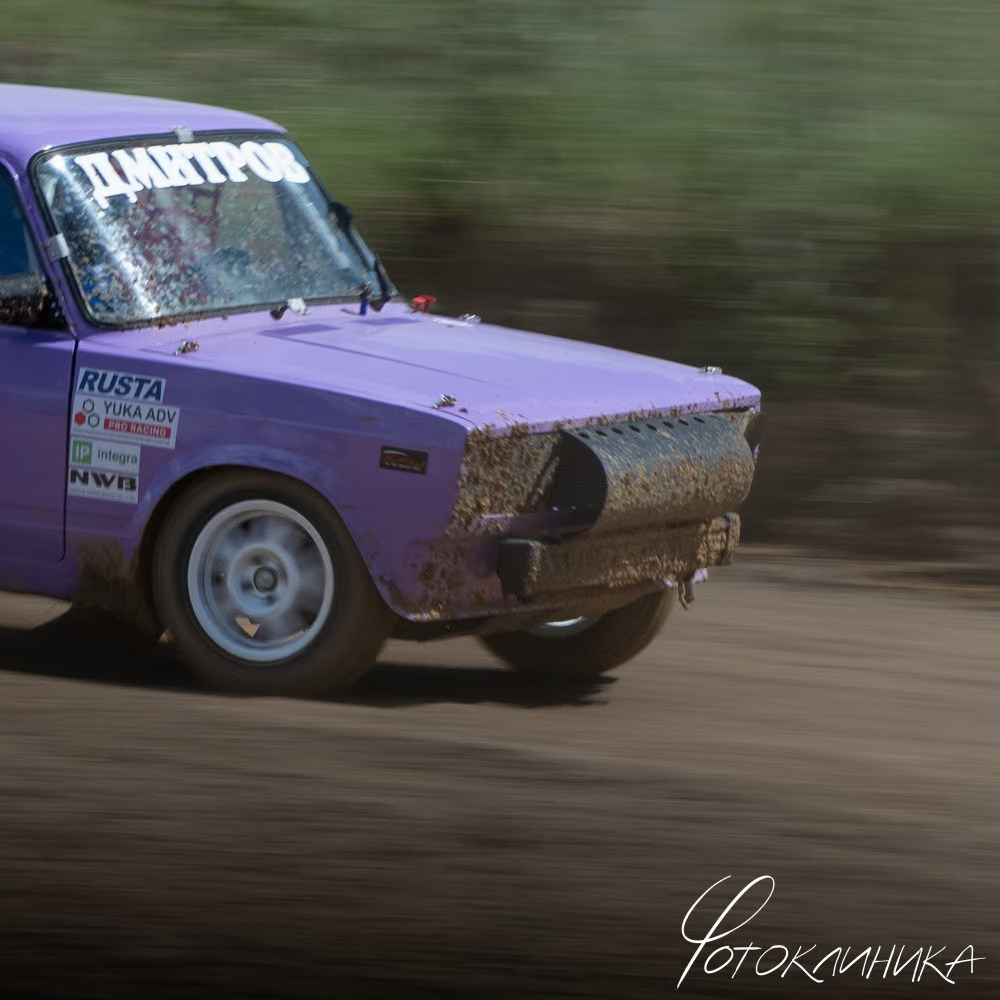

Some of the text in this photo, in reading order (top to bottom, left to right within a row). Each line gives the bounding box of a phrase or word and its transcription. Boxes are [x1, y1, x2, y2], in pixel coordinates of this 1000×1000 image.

[79, 370, 162, 402] RUSTA
[104, 400, 177, 424] YUKA ADV
[107, 420, 128, 432] PRO
[130, 424, 168, 438] RACING
[75, 443, 91, 462] IP
[70, 470, 138, 491] NWB
